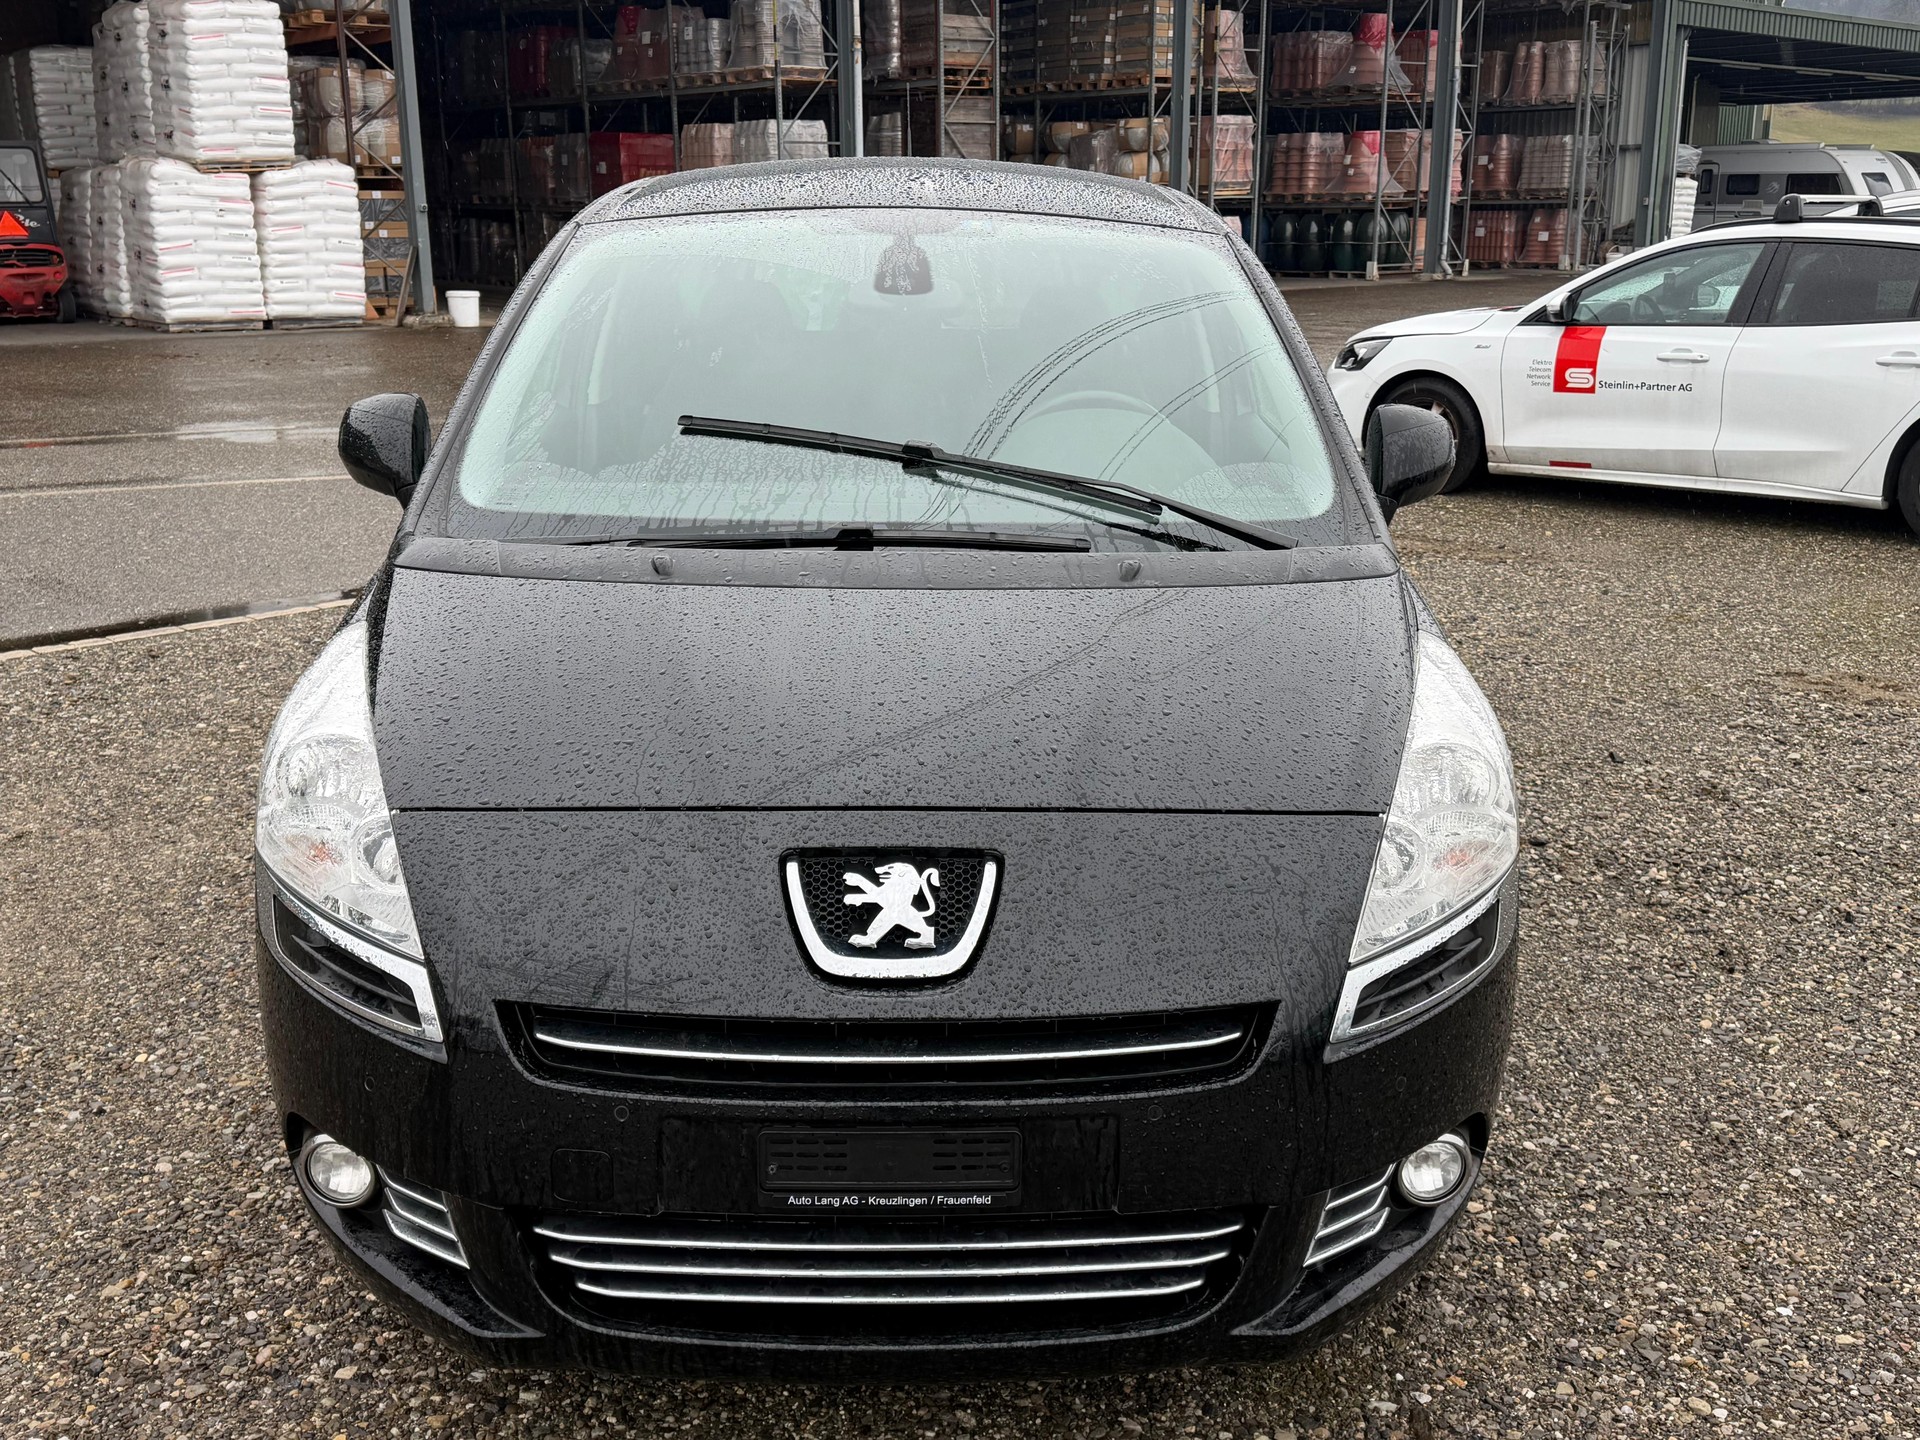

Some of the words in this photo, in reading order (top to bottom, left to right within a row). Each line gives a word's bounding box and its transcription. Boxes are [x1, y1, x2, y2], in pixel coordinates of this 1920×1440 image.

[1598, 379, 1677, 392] Steinlin+Partner
[1677, 382, 1693, 393] AG
[787, 1195, 812, 1206] Auto
[814, 1195, 840, 1208] Lang
[842, 1195, 859, 1206] AG
[868, 1195, 928, 1208] Kreuzlingen
[937, 1194, 992, 1206] Frauenfeld
